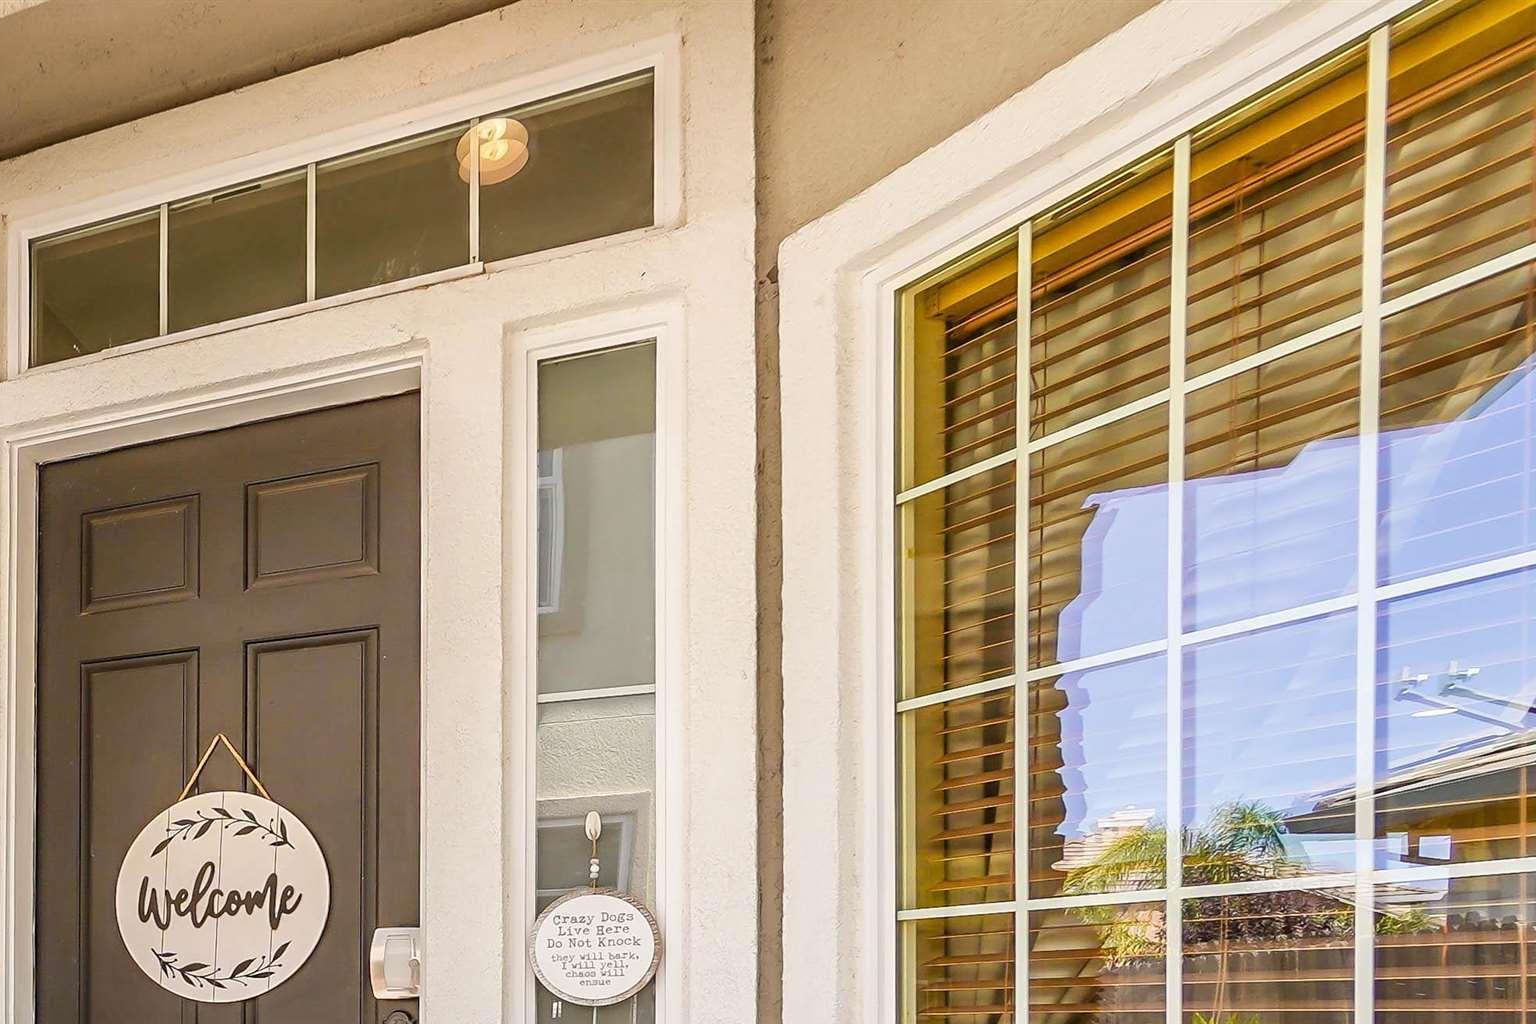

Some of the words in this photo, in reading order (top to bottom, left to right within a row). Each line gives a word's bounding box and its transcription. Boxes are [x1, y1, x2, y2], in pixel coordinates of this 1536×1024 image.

[137, 861, 303, 931] Welcome
[552, 915, 596, 926] Crazy
[601, 912, 634, 923] Dogs
[558, 926, 590, 937] Live
[596, 925, 630, 936] Here
[547, 938, 563, 949] Do
[569, 937, 592, 948] Not
[597, 936, 641, 948] Knock
[551, 953, 576, 963] they
[579, 953, 604, 961] will
[561, 961, 567, 970] I
[571, 961, 596, 969] will
[565, 970, 597, 978] chaos
[600, 969, 625, 977] will
